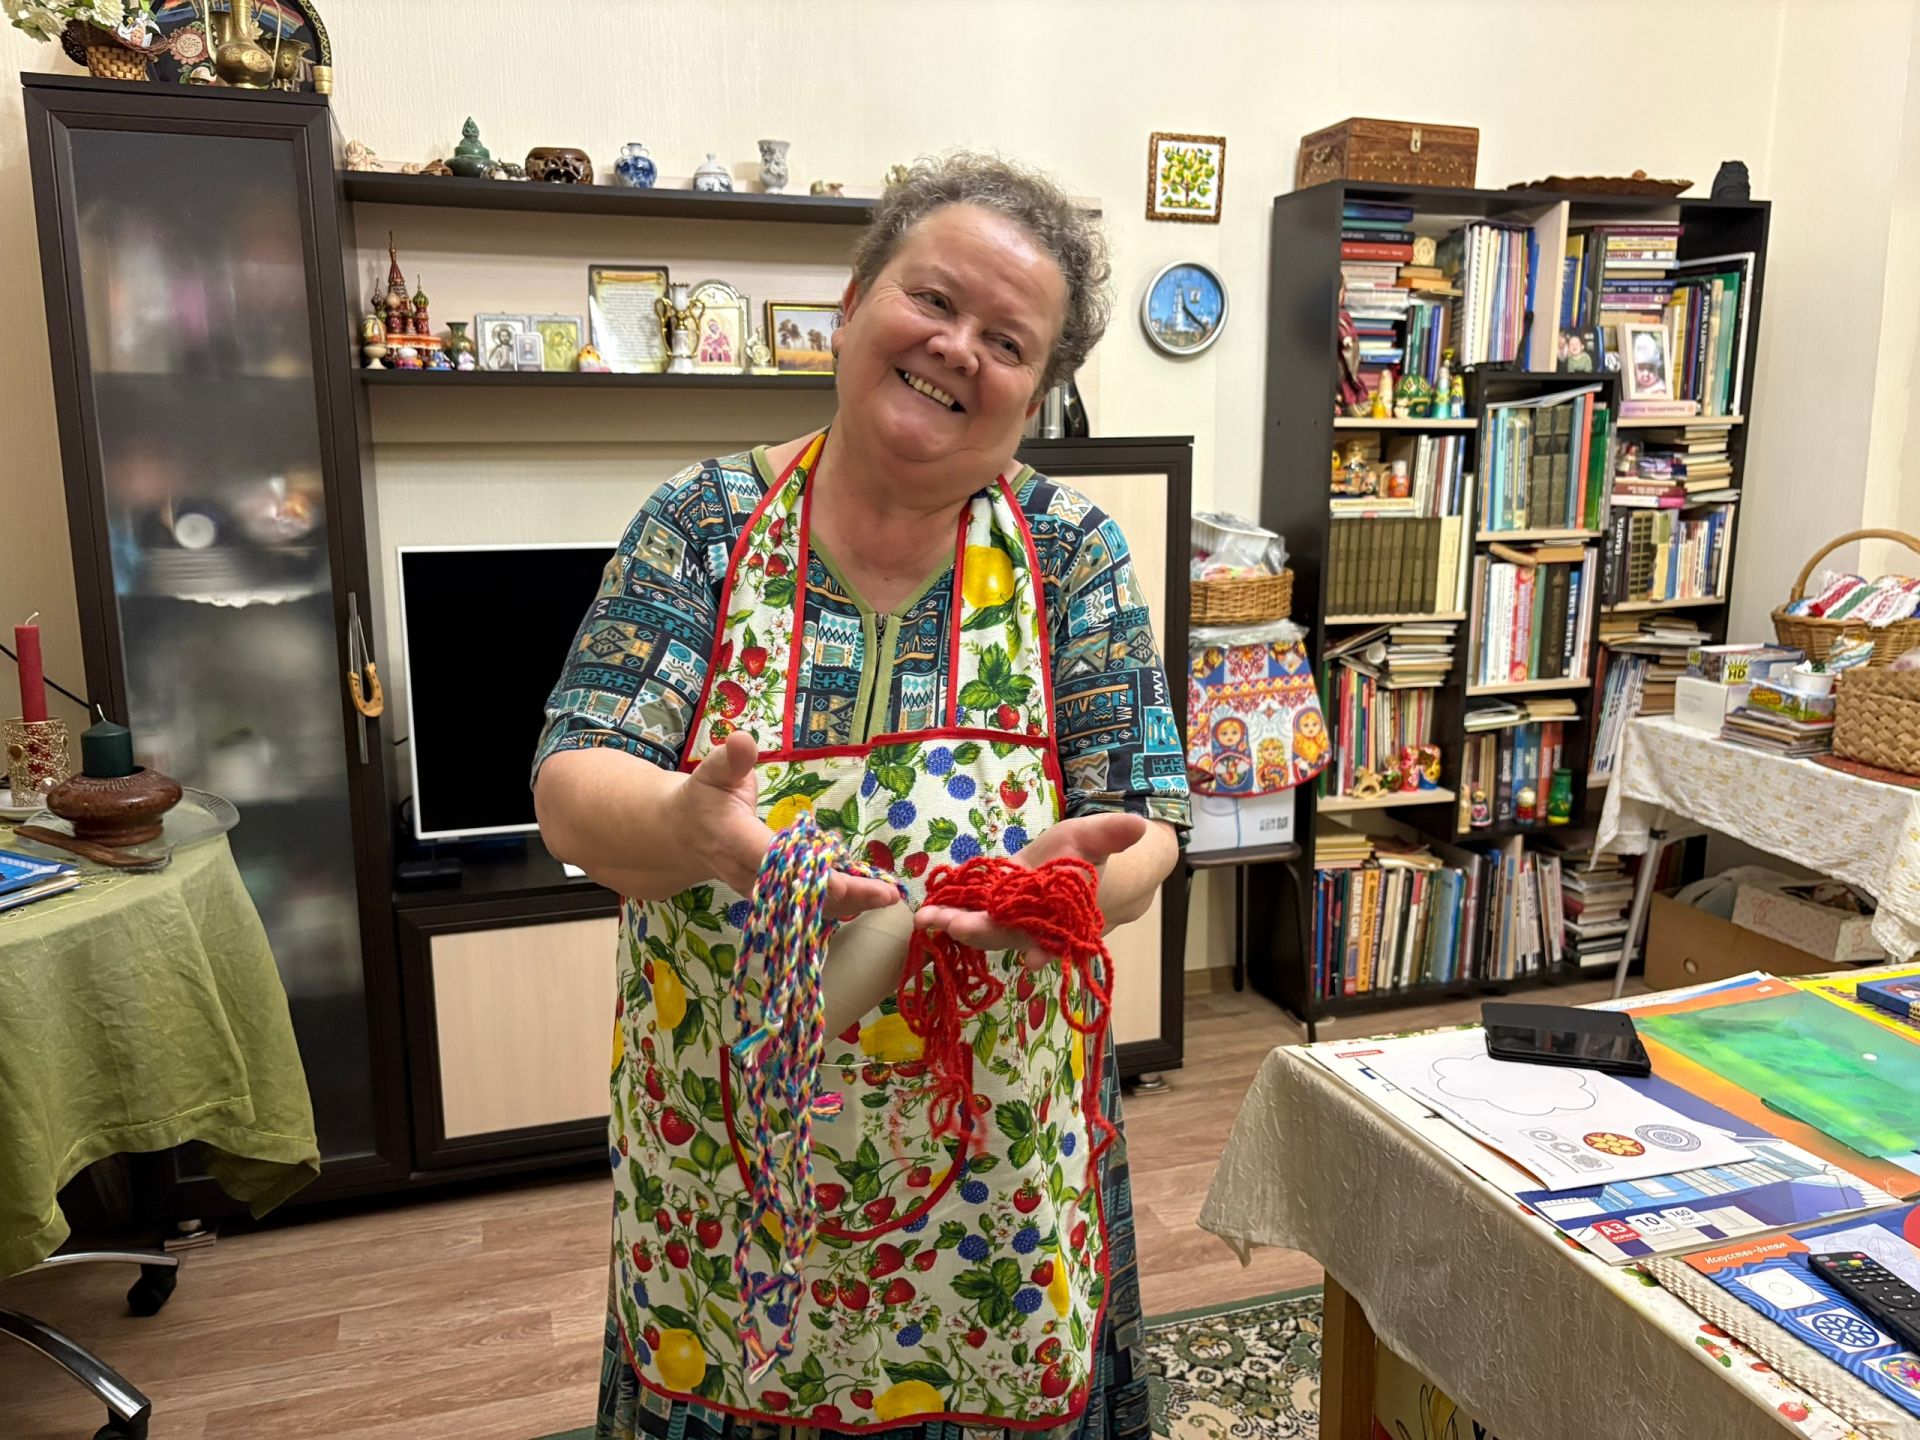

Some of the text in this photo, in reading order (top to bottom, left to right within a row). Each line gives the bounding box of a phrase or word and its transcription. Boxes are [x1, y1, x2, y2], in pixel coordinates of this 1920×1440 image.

[1728, 669, 1746, 679] HD
[1669, 1209, 1691, 1218] 160
[1635, 1216, 1661, 1227] 10
